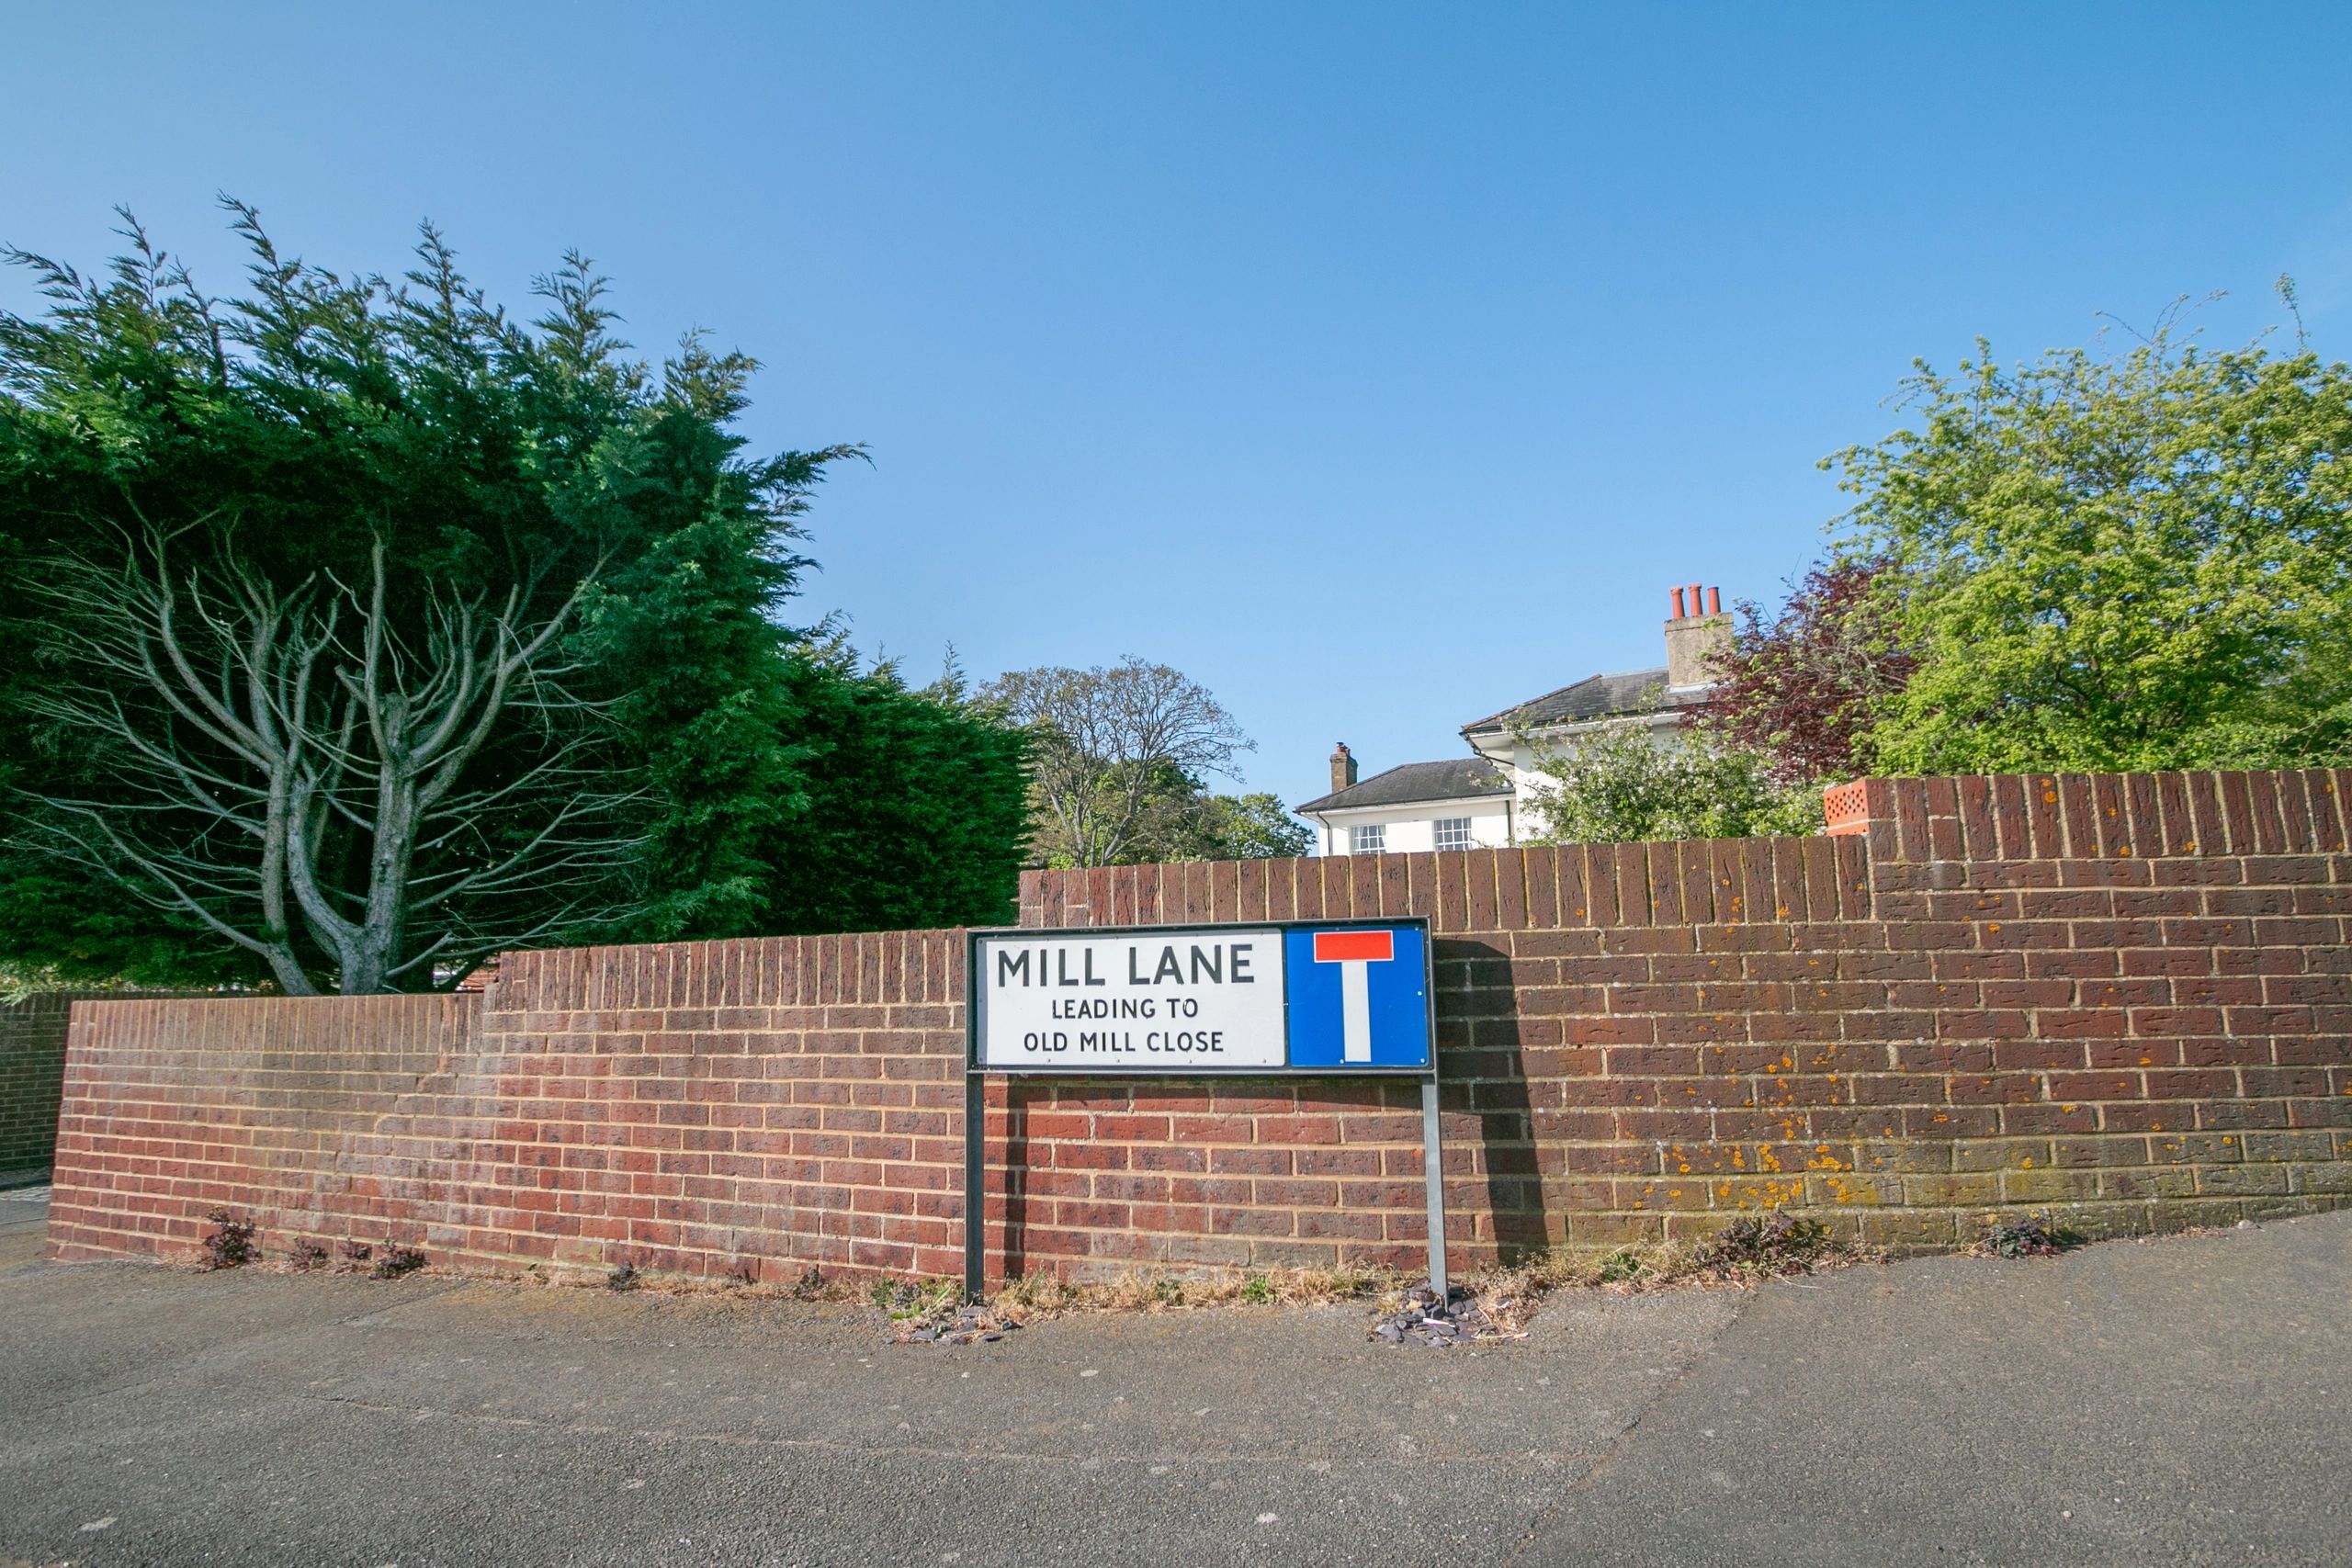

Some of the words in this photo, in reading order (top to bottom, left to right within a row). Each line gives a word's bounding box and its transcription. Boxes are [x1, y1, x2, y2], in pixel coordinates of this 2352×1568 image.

[998, 948, 1105, 987] MILL
[1129, 943, 1255, 986] LANE
[1052, 998, 1156, 1020] LEADING
[1166, 998, 1198, 1019] TO
[1023, 1032, 1068, 1052] OLD
[1080, 1032, 1136, 1052] MILL
[1147, 1031, 1224, 1053] CLOSE
